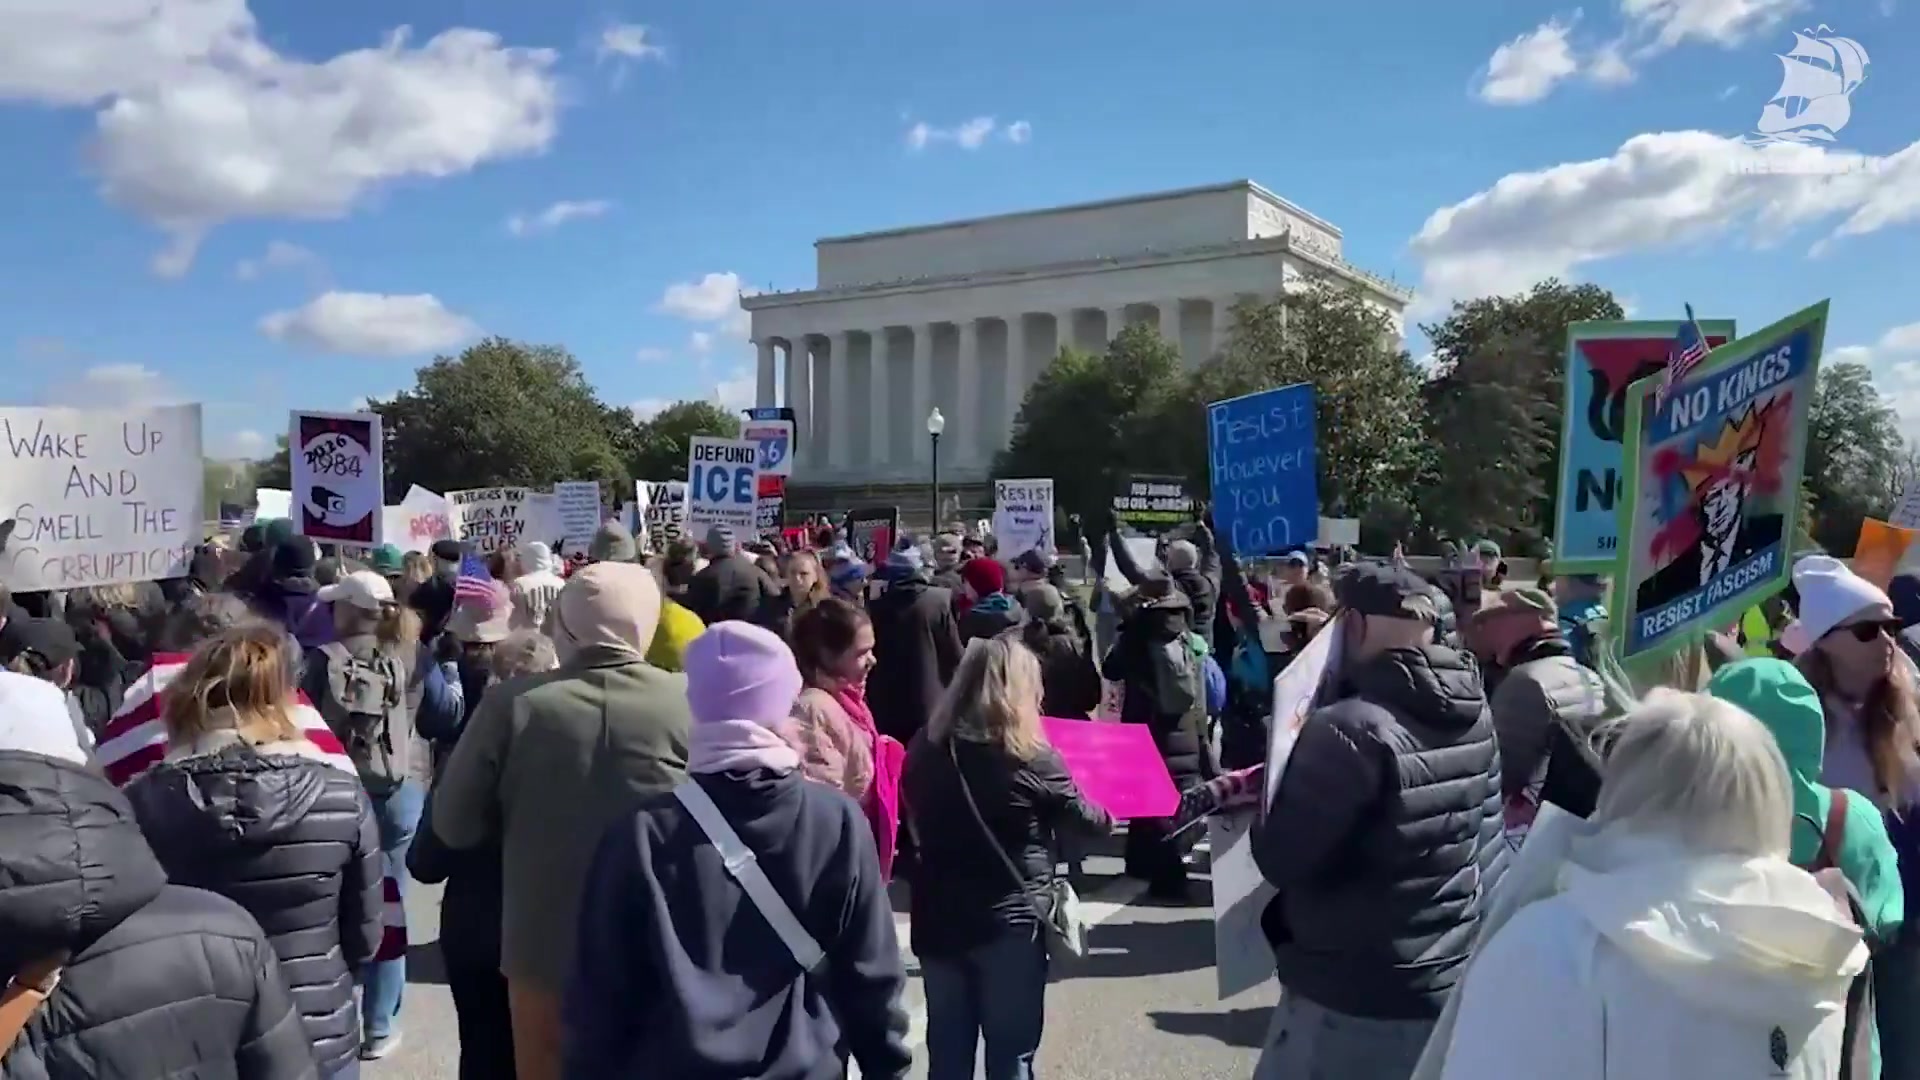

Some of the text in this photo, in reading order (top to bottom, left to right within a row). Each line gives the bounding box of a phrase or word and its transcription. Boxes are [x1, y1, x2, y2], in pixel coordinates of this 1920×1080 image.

[1670, 345, 1792, 433] NO KINGS
[5, 418, 164, 459] WAKE UP
[1211, 399, 1304, 446] Resist
[303, 432, 347, 465] 2026
[311, 453, 363, 478] 1984
[694, 444, 755, 464] DEFUND
[1211, 448, 1305, 487] However
[64, 464, 138, 499] AND
[692, 464, 754, 504] ICE
[14, 500, 178, 543] SMELL THE
[499, 504, 517, 518] AT
[1231, 515, 1290, 558] Can
[1641, 550, 1774, 639] RESIST FASCISM
